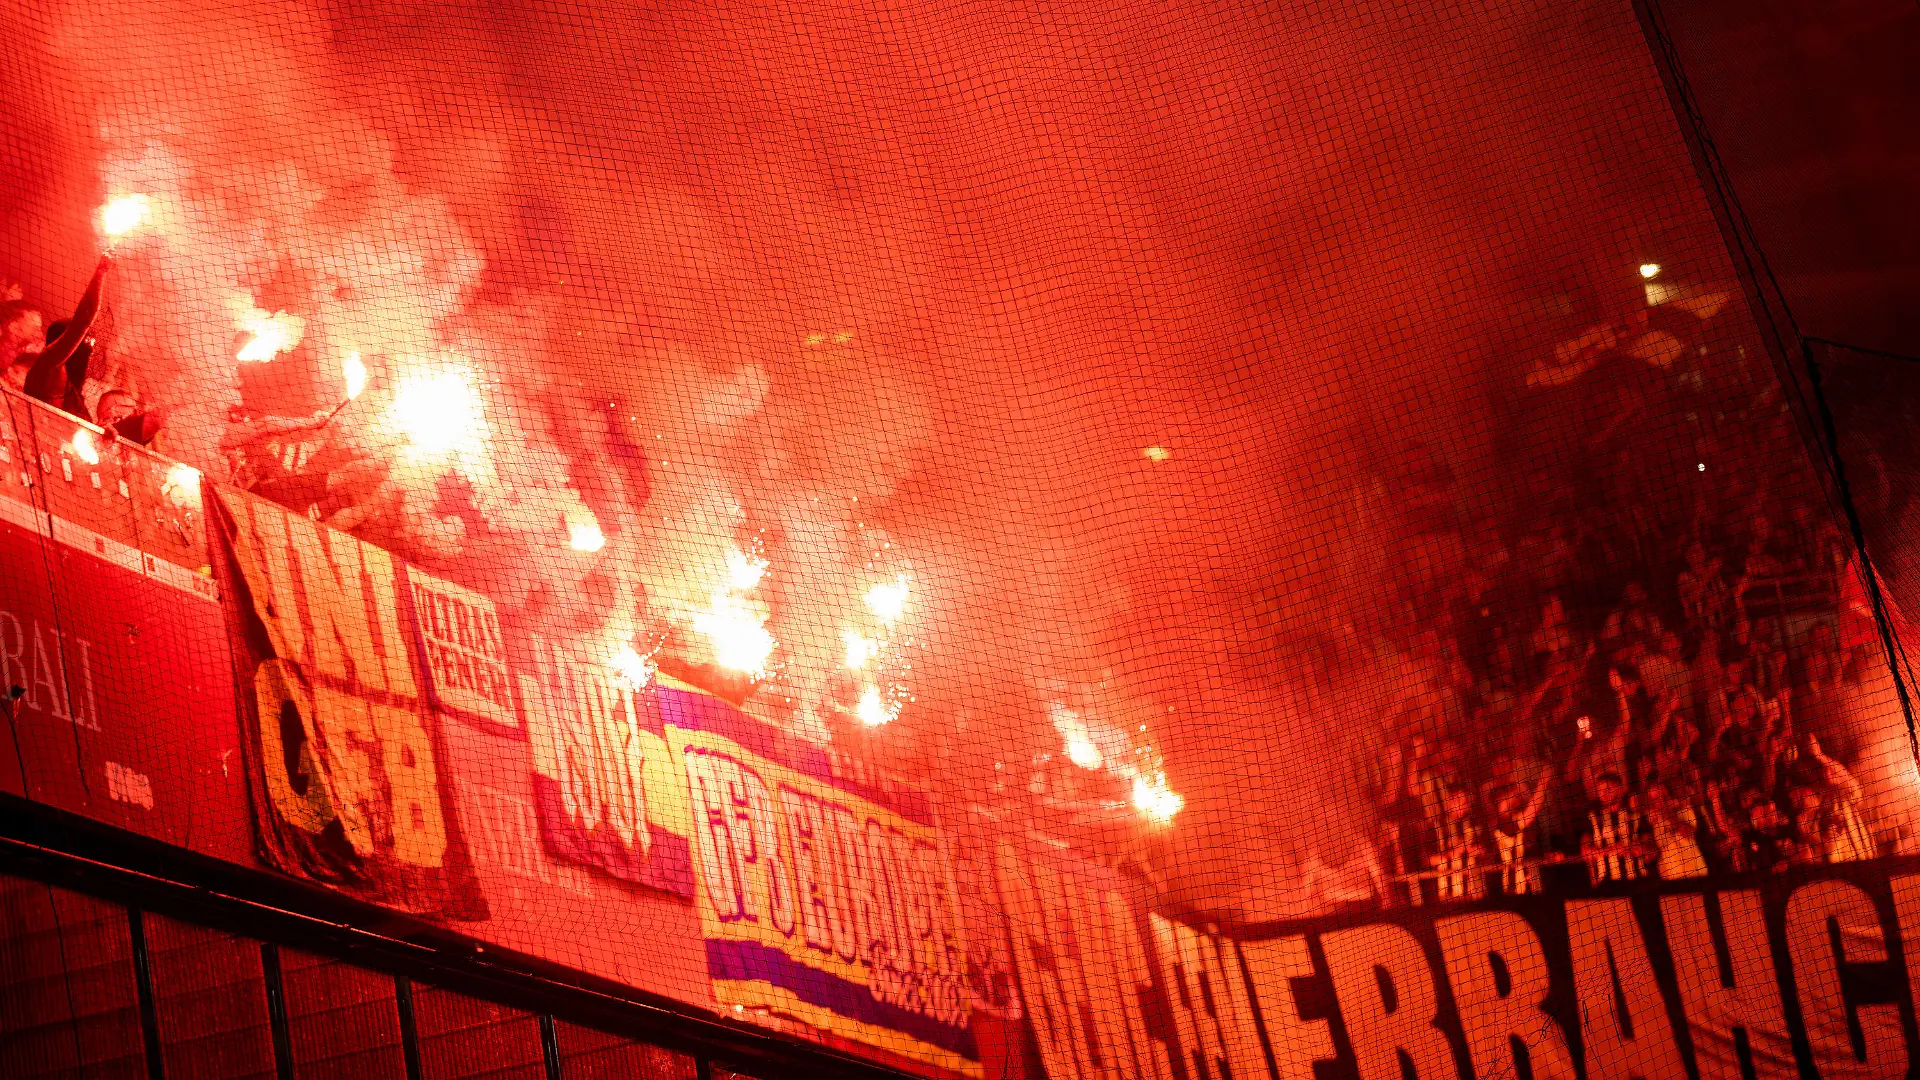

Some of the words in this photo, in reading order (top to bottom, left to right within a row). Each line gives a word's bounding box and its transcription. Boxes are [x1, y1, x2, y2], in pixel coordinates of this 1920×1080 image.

[217, 486, 418, 699] UNI
[411, 581, 505, 662] ULTRAS
[424, 636, 515, 713] FENER
[253, 657, 448, 868] GFB
[685, 744, 795, 938] GFB
[780, 781, 965, 978] EUROPE
[1150, 873, 1920, 1080] FENERBAHC
